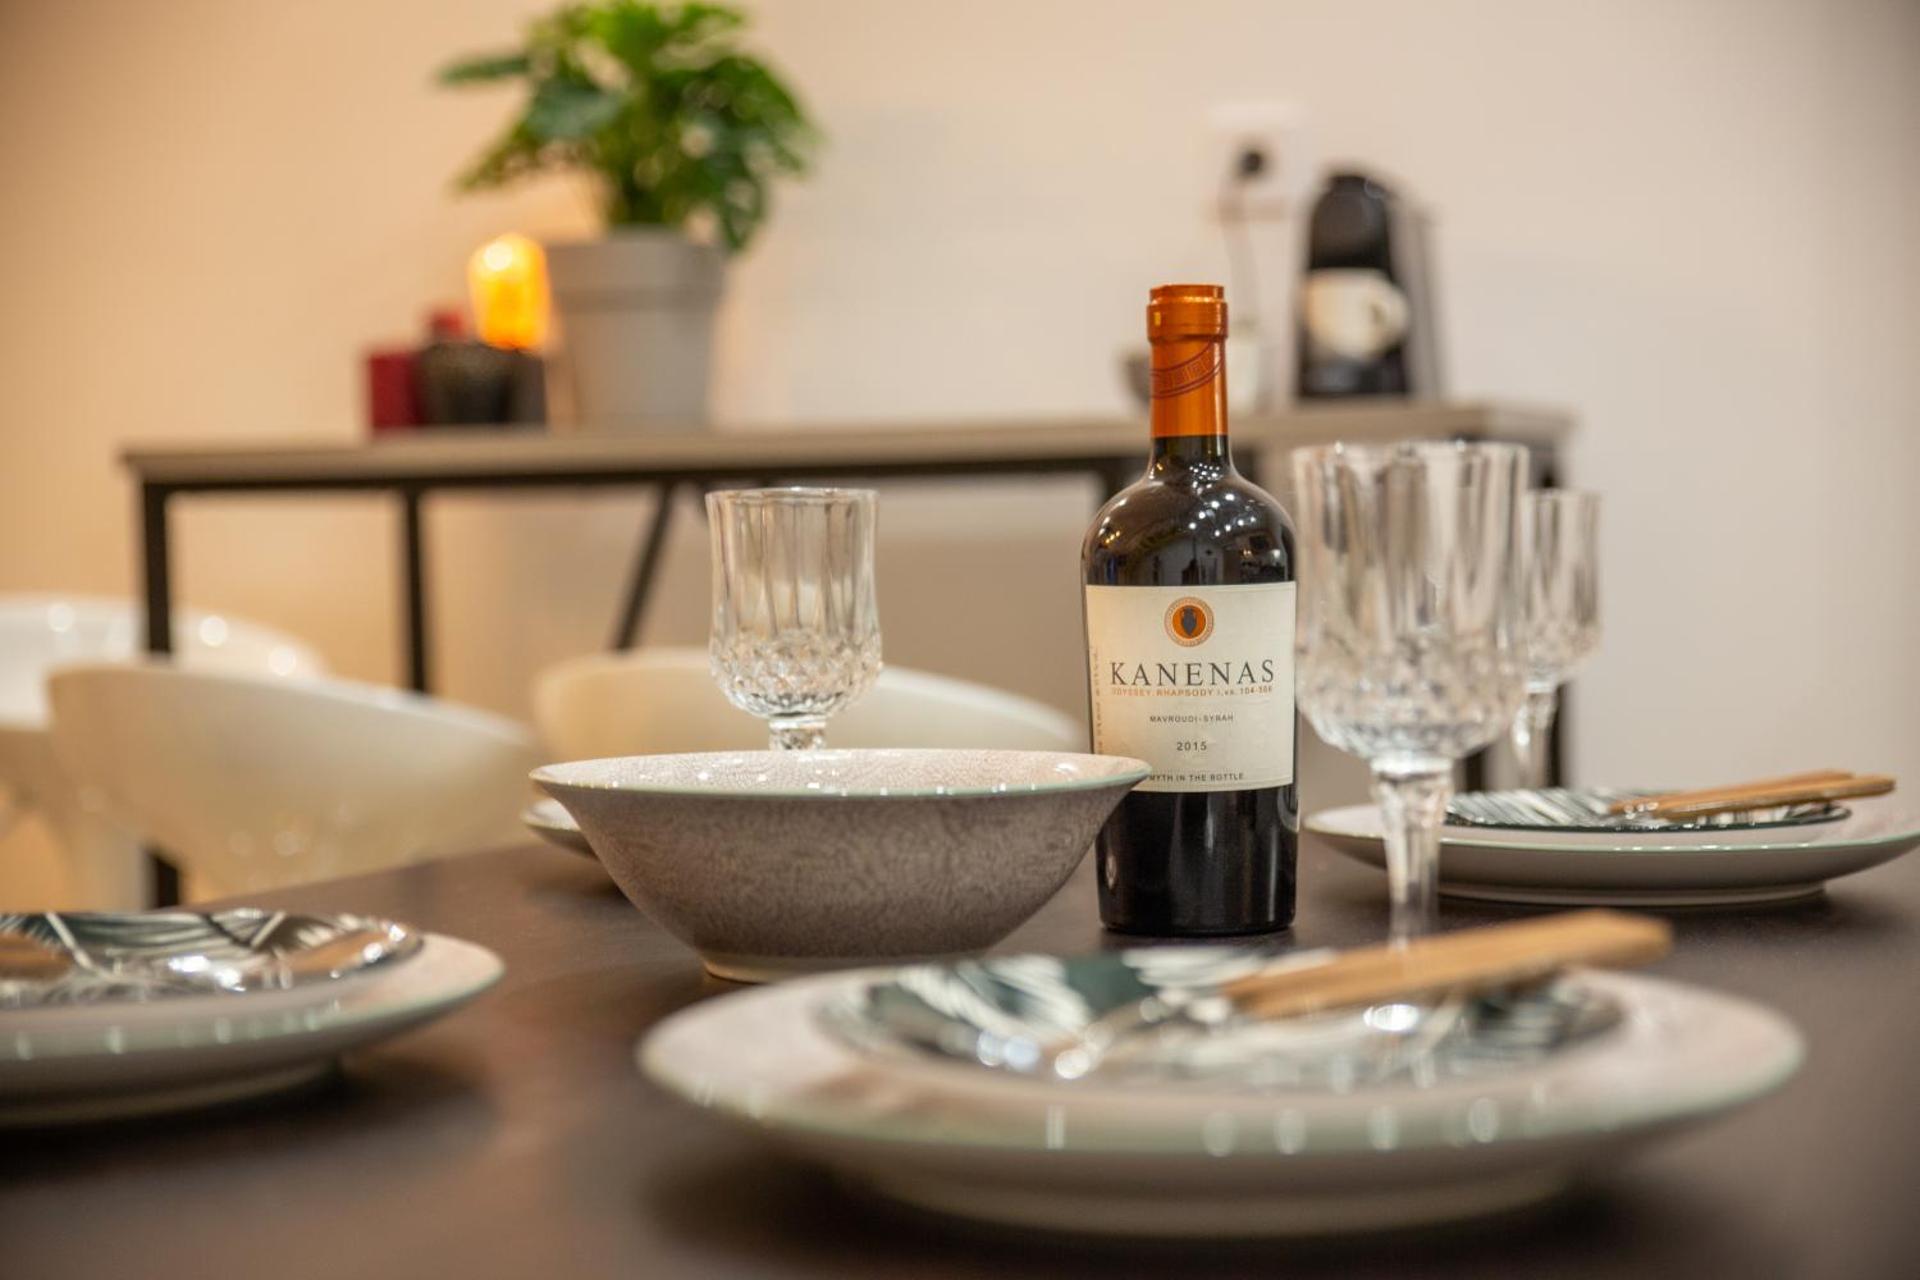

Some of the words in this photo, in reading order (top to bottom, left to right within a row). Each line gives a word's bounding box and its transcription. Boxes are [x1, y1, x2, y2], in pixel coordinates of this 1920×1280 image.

[1110, 659, 1275, 686] KANENAS
[1156, 687, 1213, 697] RHAPSODY
[1176, 741, 1207, 751] 2015
[1176, 773, 1185, 781] IN
[1189, 773, 1207, 781] THE
[1210, 772, 1243, 781] BOTTLE
